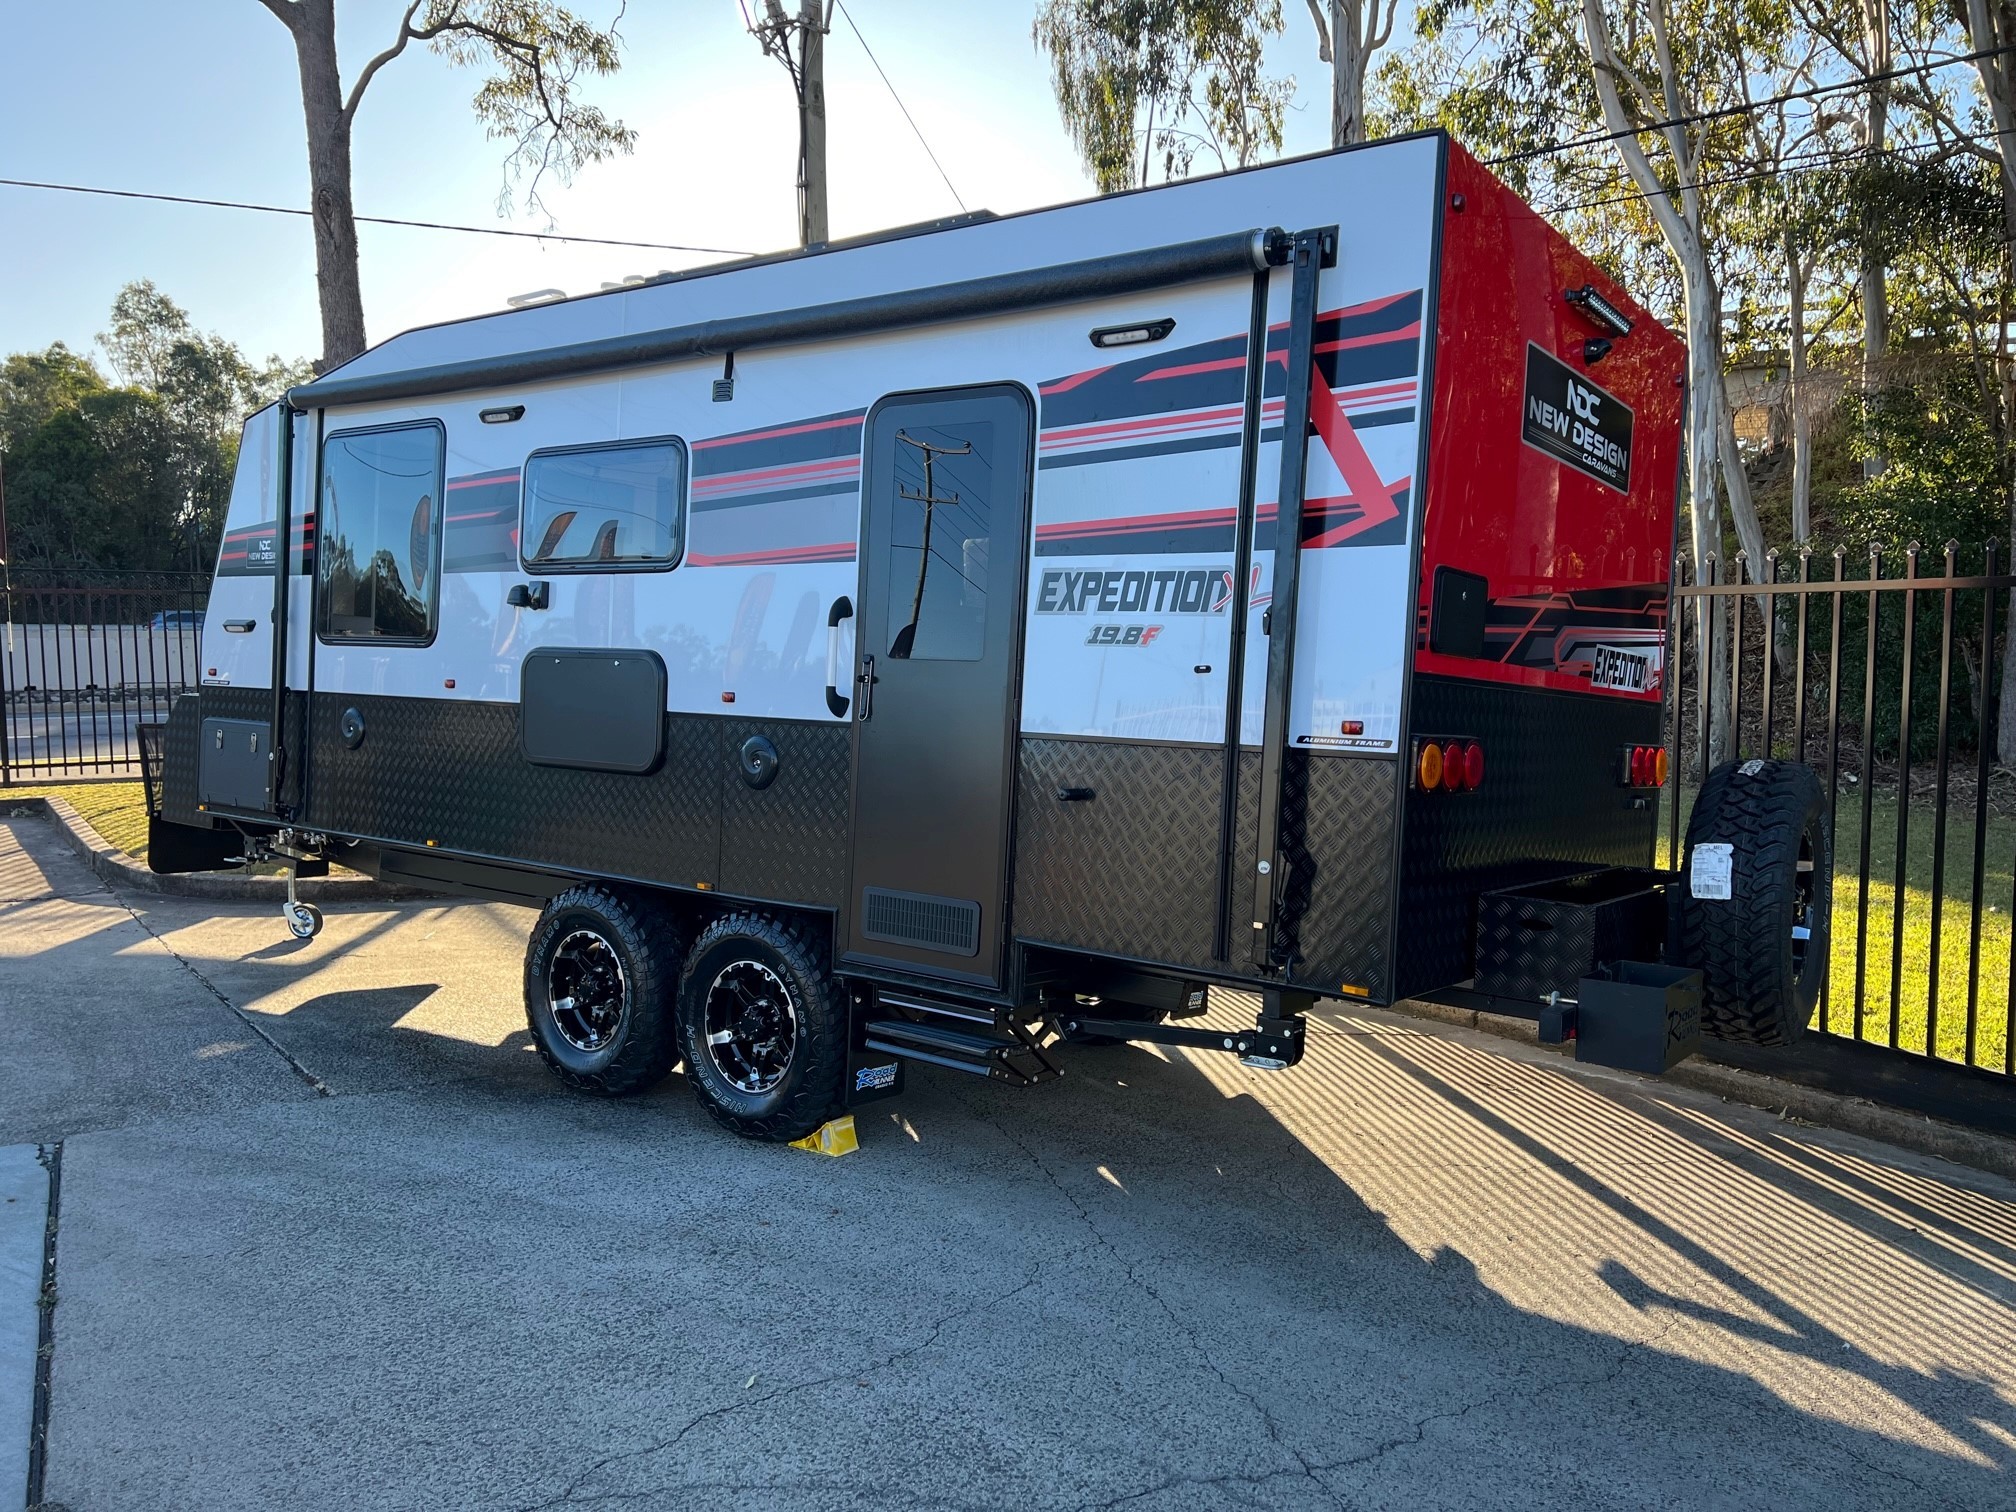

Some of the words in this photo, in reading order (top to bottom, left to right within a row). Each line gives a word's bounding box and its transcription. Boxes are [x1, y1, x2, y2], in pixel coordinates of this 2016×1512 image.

[1566, 379, 1601, 427] NDC
[1529, 395, 1570, 438] NEW
[1572, 421, 1627, 471] DESIGN
[1582, 453, 1617, 478] CARAVANS
[248, 551, 261, 560] NEW
[259, 540, 272, 551] NDC
[1036, 570, 1232, 613] EXPEDITION
[1593, 647, 1648, 690] EXPEDITION
[1303, 737, 1352, 745] ALUMINIUM
[531, 919, 560, 977] DYNAMO
[776, 963, 808, 1038] DYNAMO
[685, 1023, 748, 1114] HISCEND-H
[855, 1061, 899, 1091] Road
